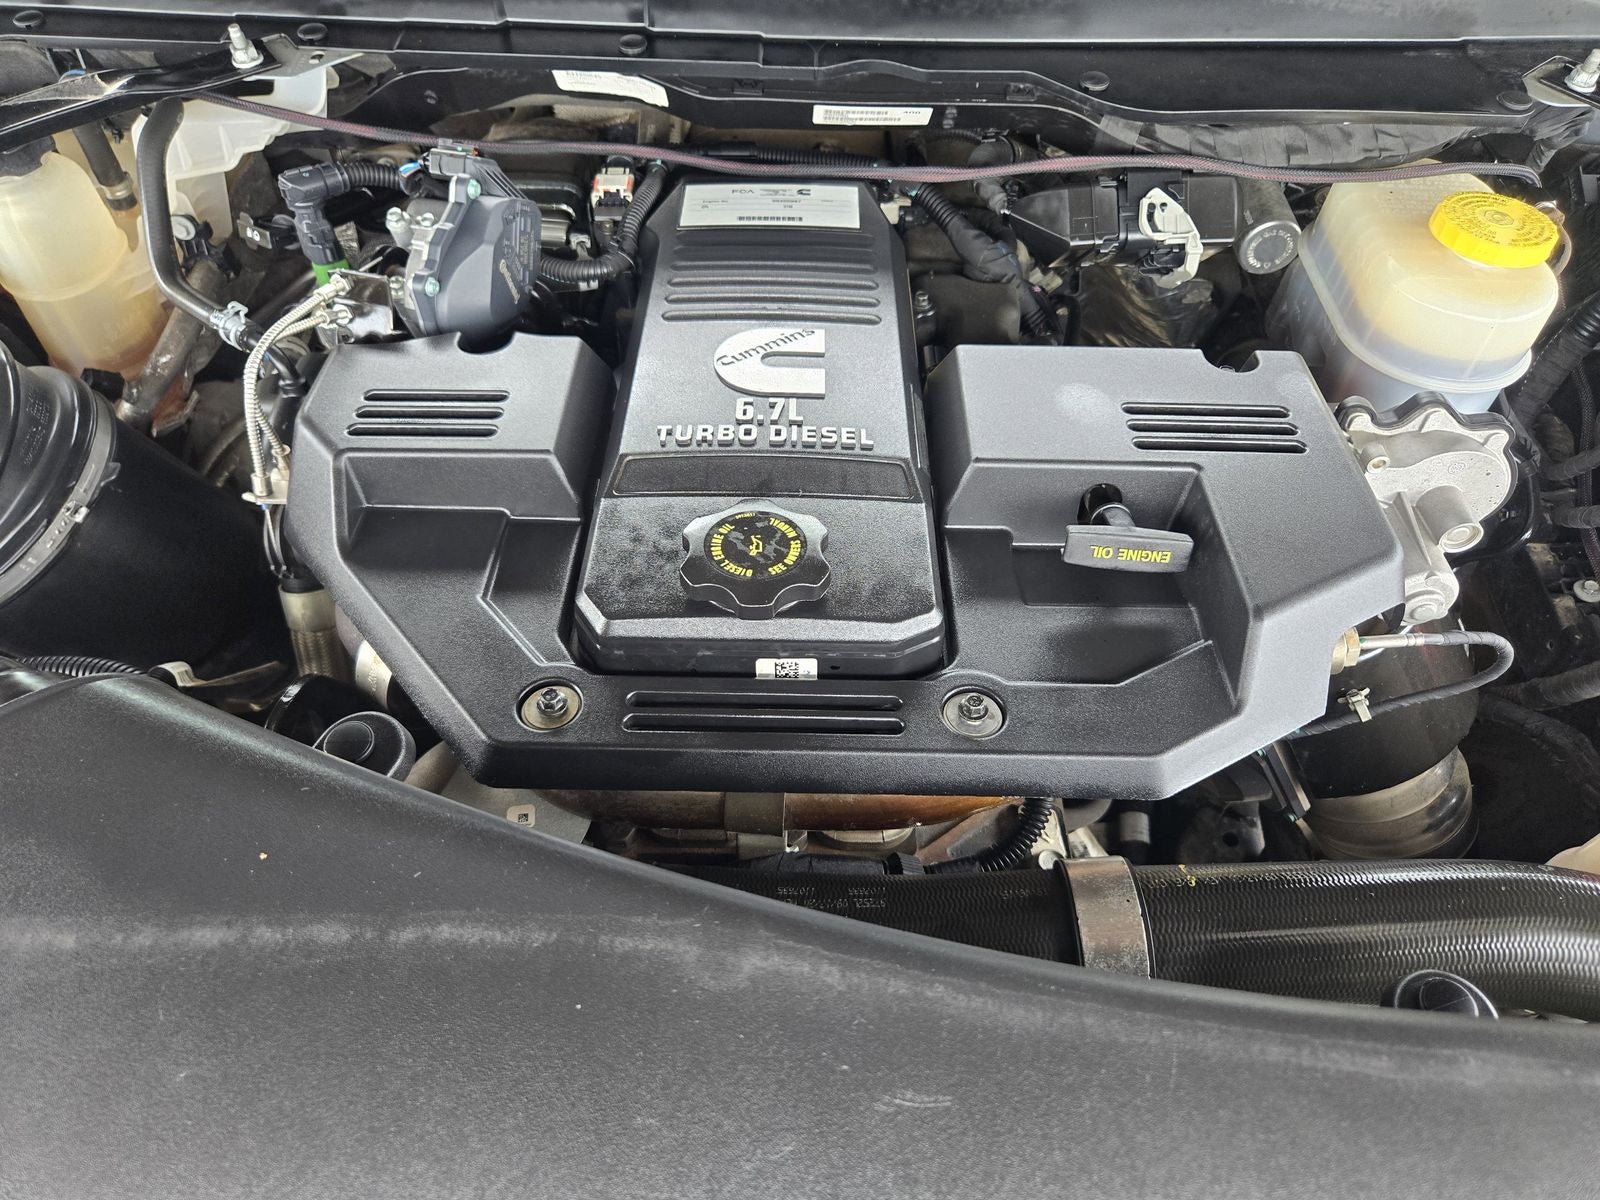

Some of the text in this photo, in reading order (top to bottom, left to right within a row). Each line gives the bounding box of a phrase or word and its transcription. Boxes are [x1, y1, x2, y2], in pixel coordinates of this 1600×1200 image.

[716, 328, 815, 366] Cummins
[735, 398, 803, 424] 6.7L
[656, 424, 874, 450] TURBO DIESEL
[769, 517, 797, 538] MANUAL
[710, 523, 753, 577] DIESEL ENGINE OIL
[1090, 545, 1171, 564] ENGINE OIL
[768, 563, 787, 575] SEE
